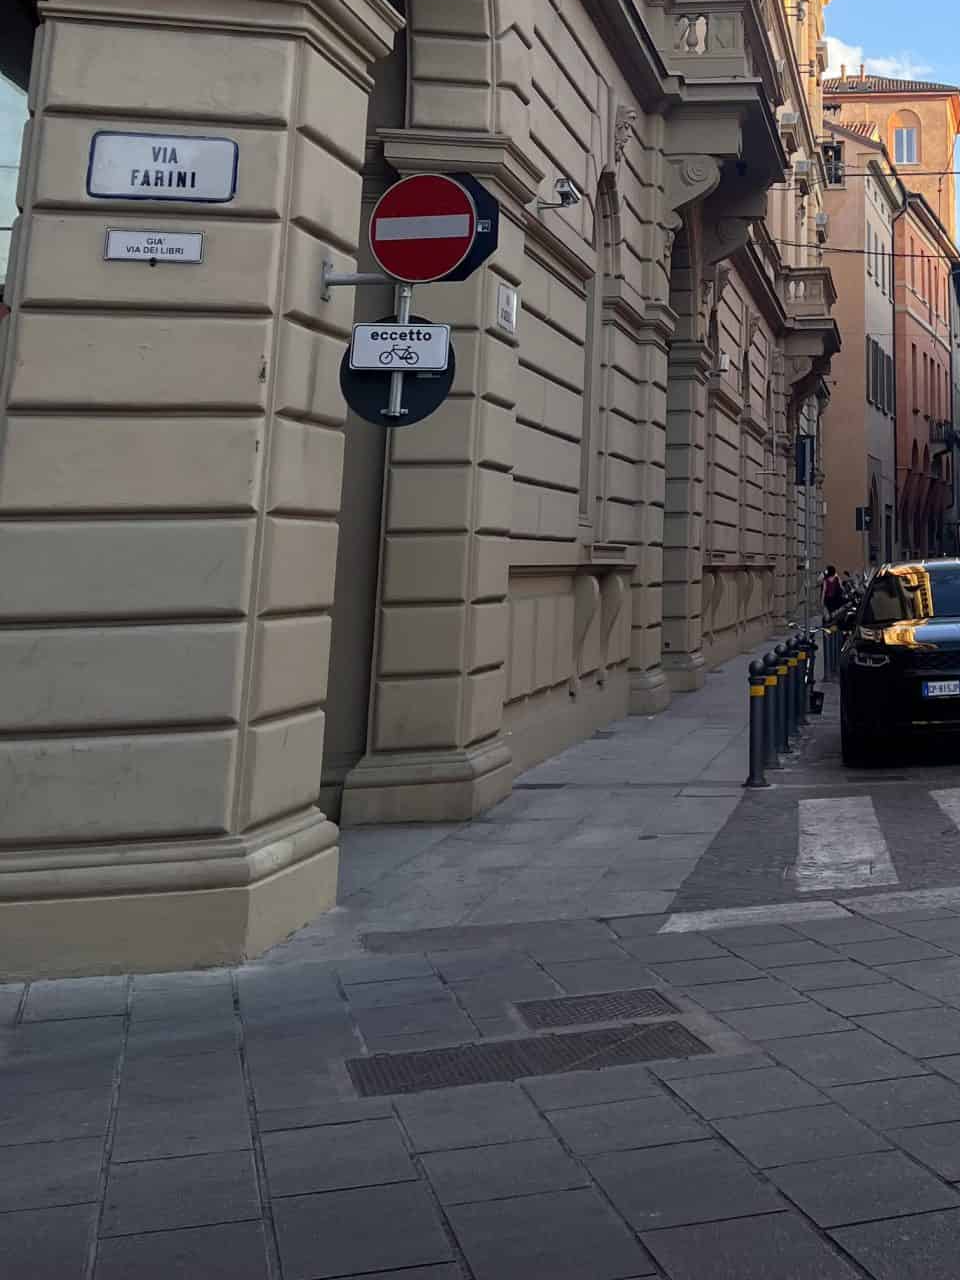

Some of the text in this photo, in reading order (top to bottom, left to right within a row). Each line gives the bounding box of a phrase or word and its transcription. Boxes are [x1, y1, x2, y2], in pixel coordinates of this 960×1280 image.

[152, 146, 178, 164] VIA
[130, 169, 196, 189] FARINI
[126, 245, 184, 255] VIA DEI LIBRI
[370, 328, 432, 341] eccetto
